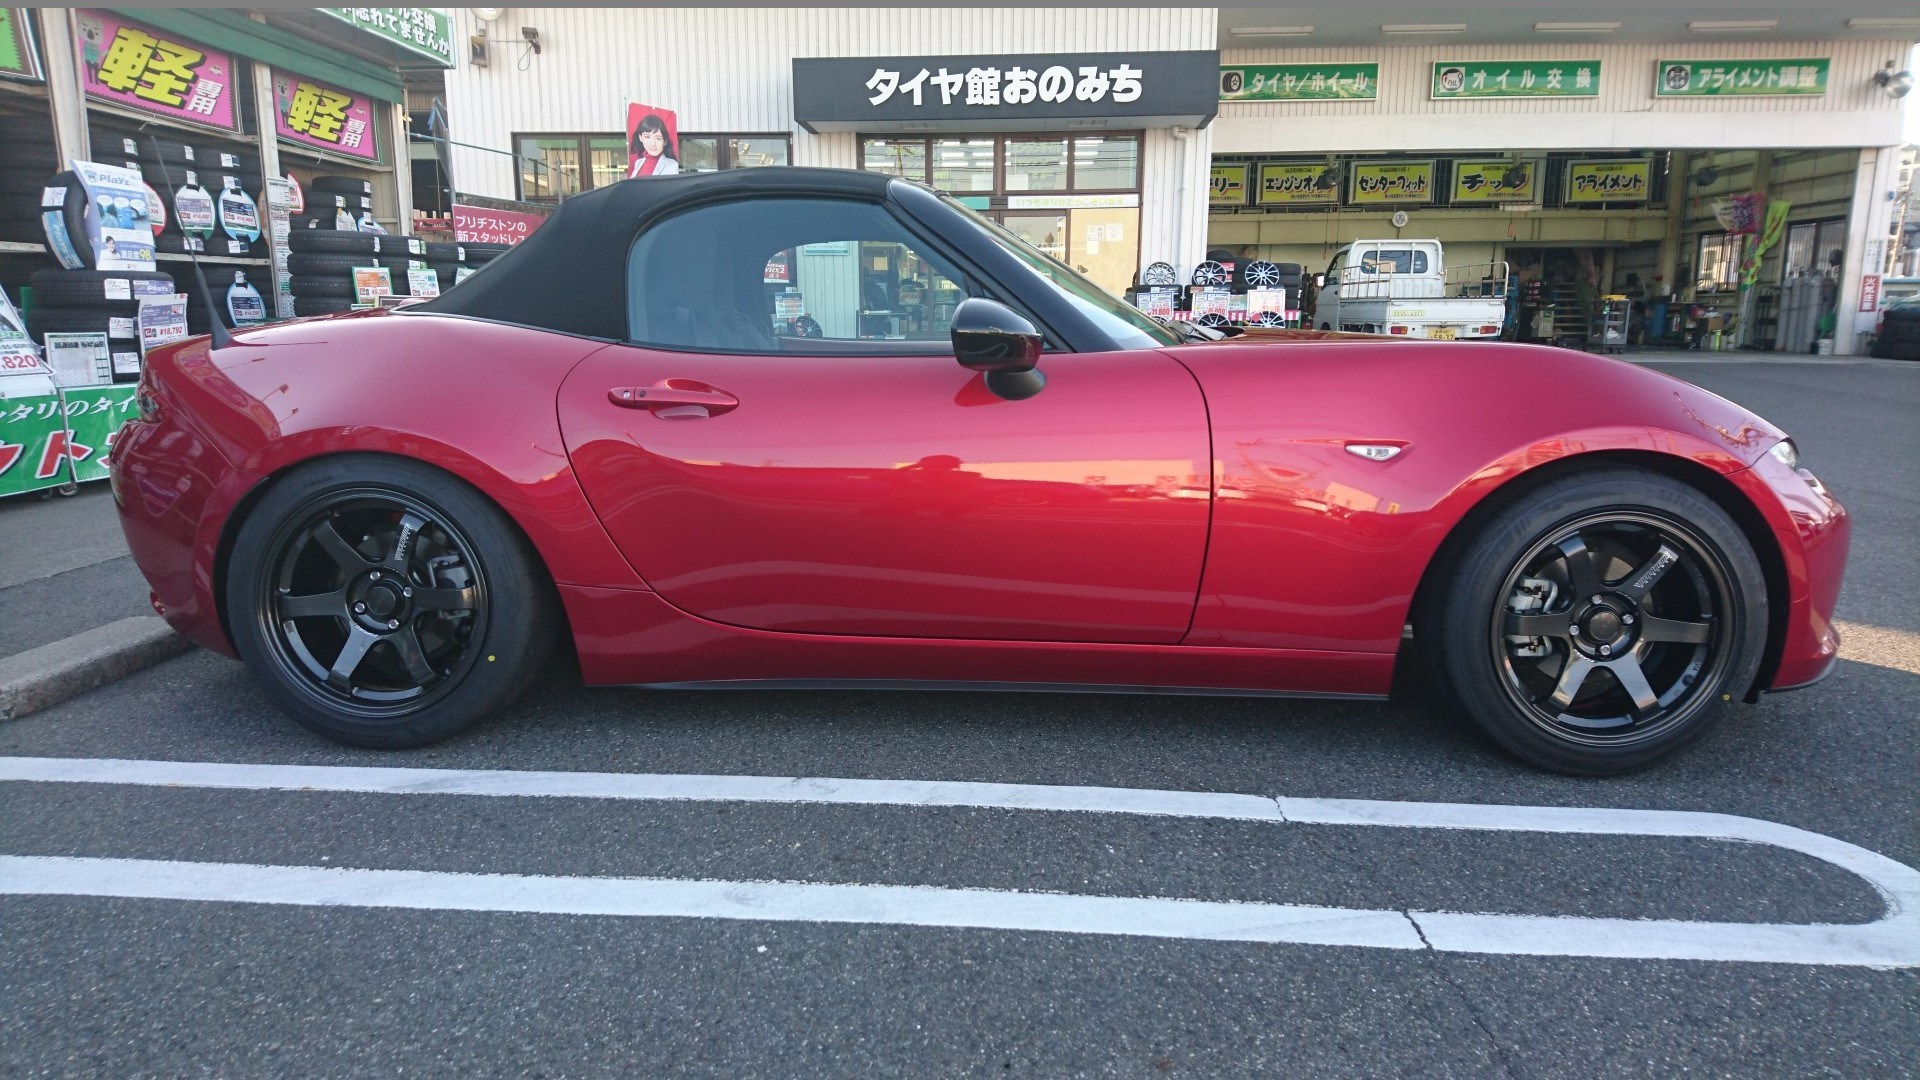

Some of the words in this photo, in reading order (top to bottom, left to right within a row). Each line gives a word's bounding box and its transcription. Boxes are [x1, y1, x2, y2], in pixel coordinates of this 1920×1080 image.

[98, 26, 207, 110] 軽
[1472, 68, 1591, 90] オイル交換
[1698, 66, 1819, 88] アライメント調整
[187, 78, 224, 115] 専用
[865, 64, 1143, 107] タイヤ館おのみち
[287, 81, 354, 144] 軽
[341, 118, 367, 148] 専用
[99, 174, 130, 186] Playz
[1575, 174, 1643, 190] アライメント
[455, 216, 527, 233] ブリヂストンの
